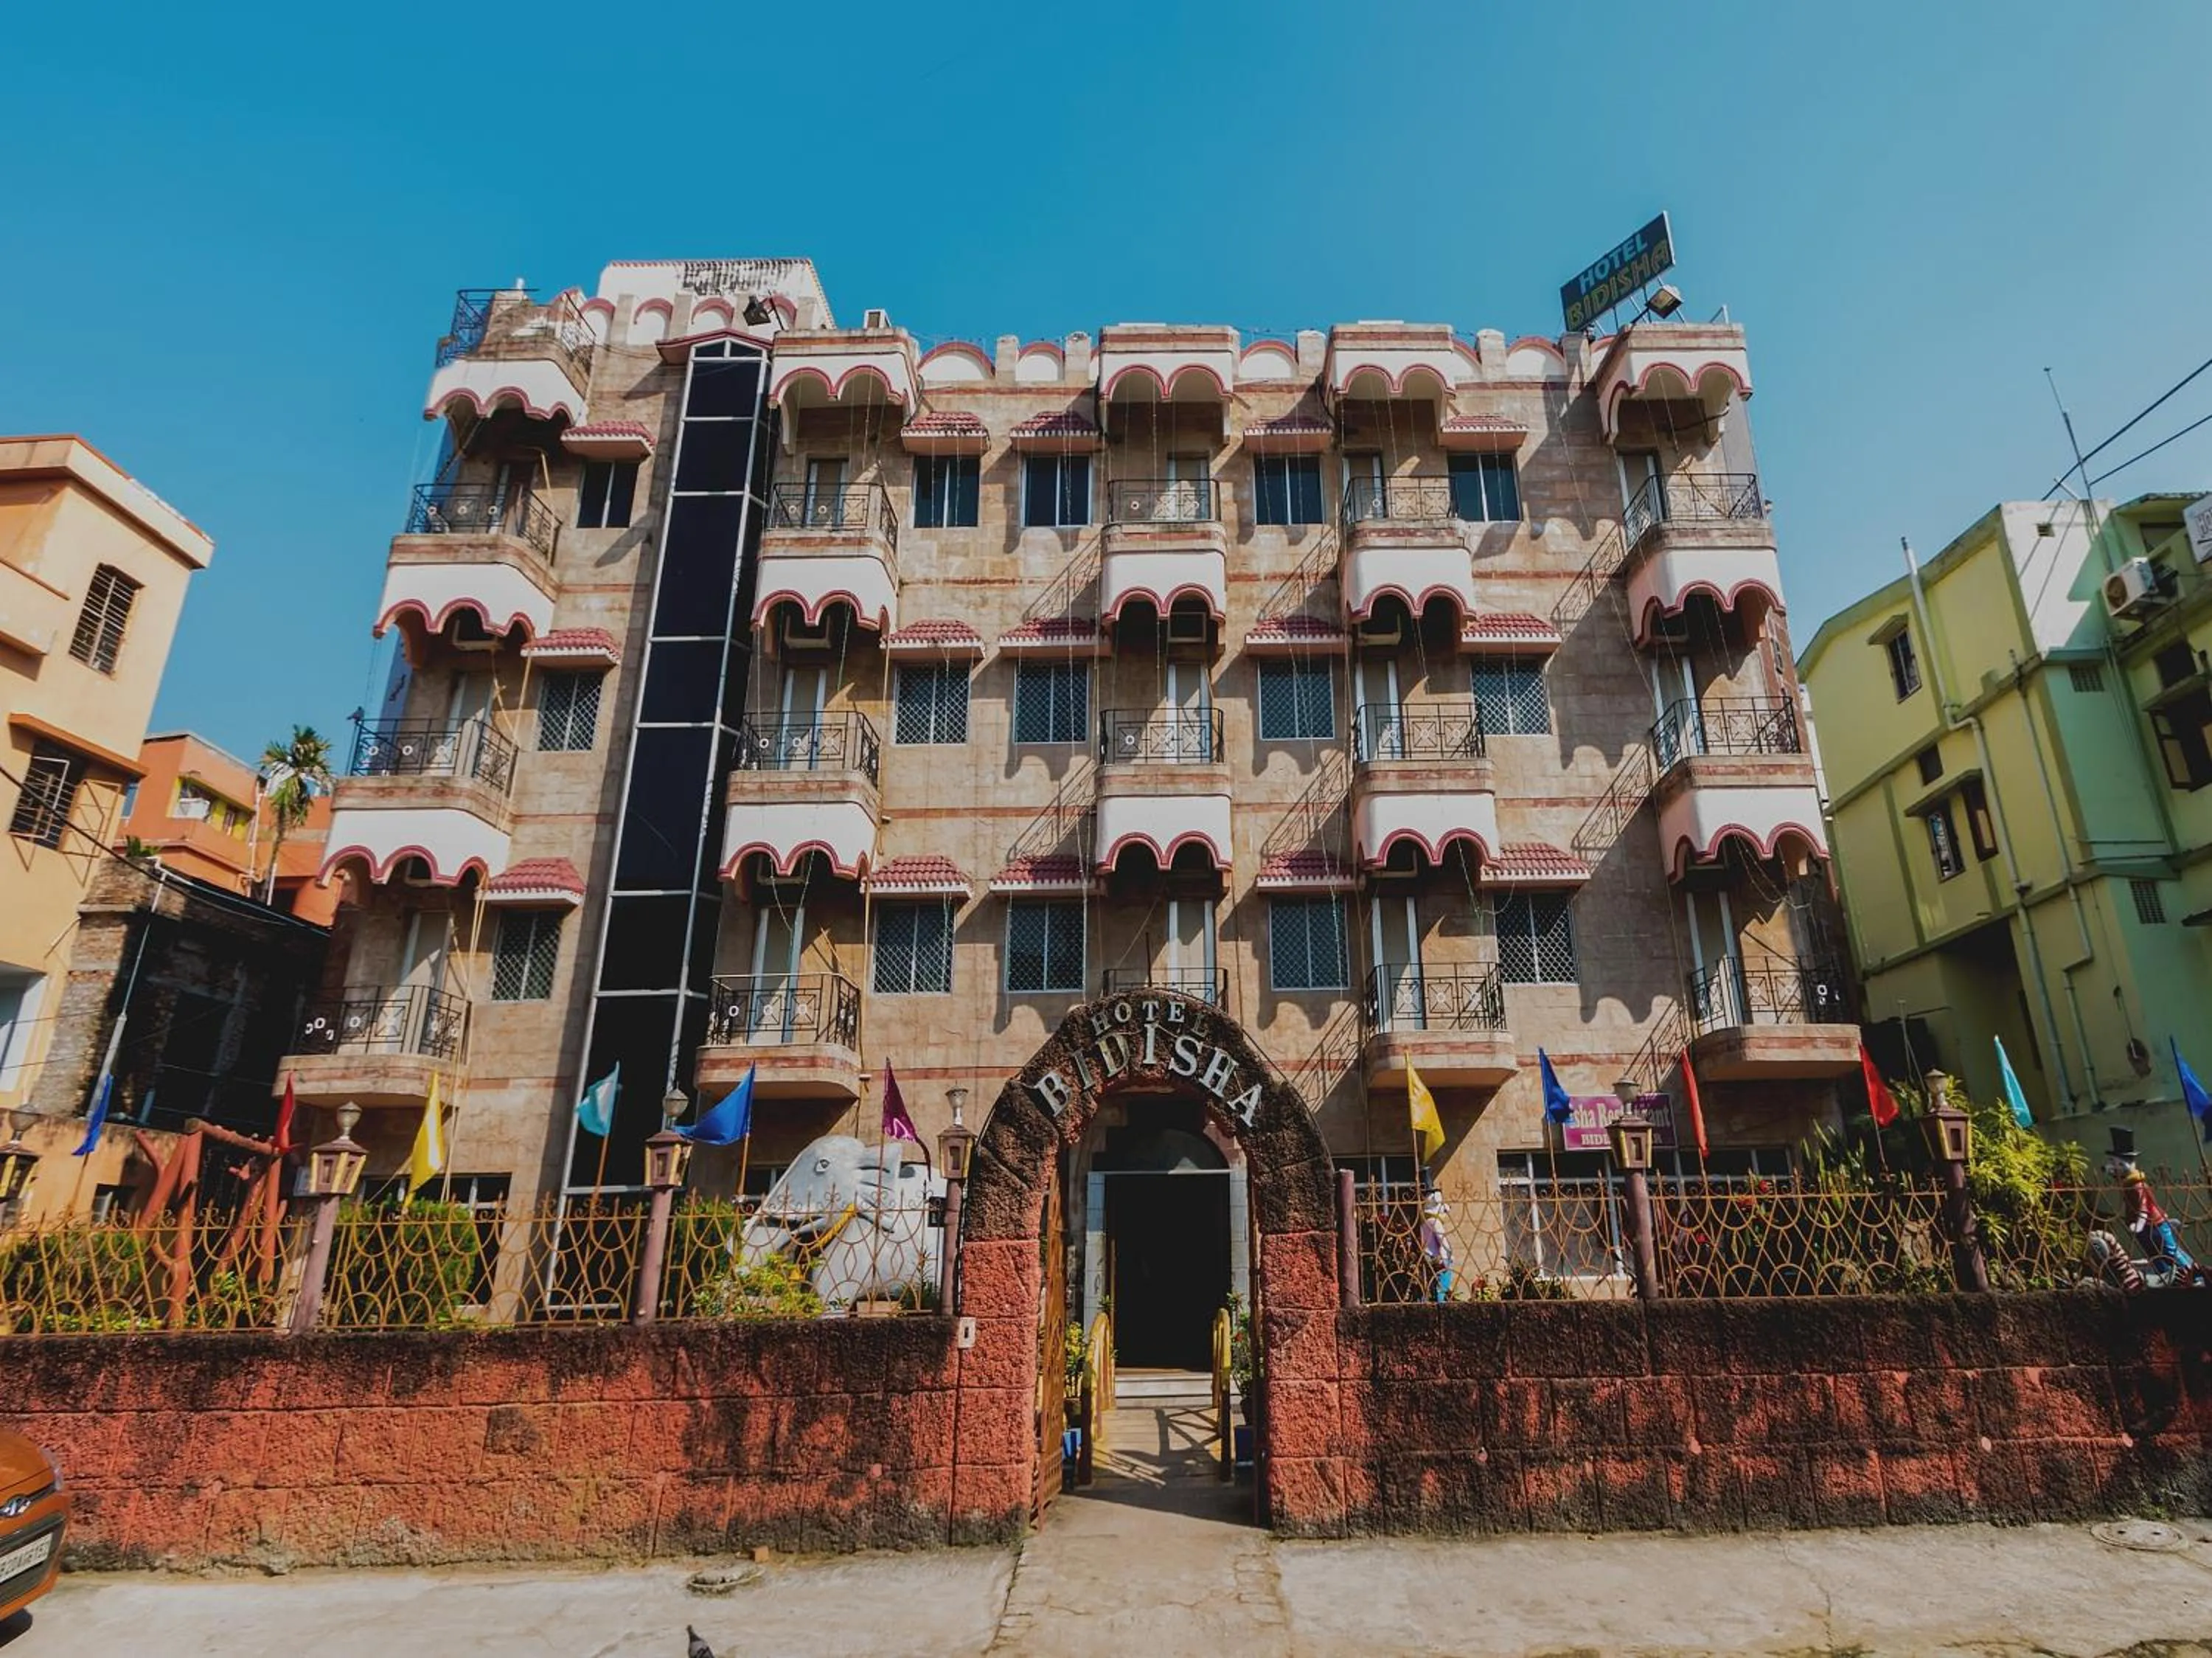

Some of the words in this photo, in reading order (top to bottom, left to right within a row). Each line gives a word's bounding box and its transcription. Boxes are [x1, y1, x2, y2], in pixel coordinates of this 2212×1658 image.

[1566, 239, 1670, 331] BIDISHA
[1577, 233, 1648, 296] HOTEL
[1091, 1000, 1208, 1037] HOTEL
[1033, 1023, 1262, 1128] BIDISHA
